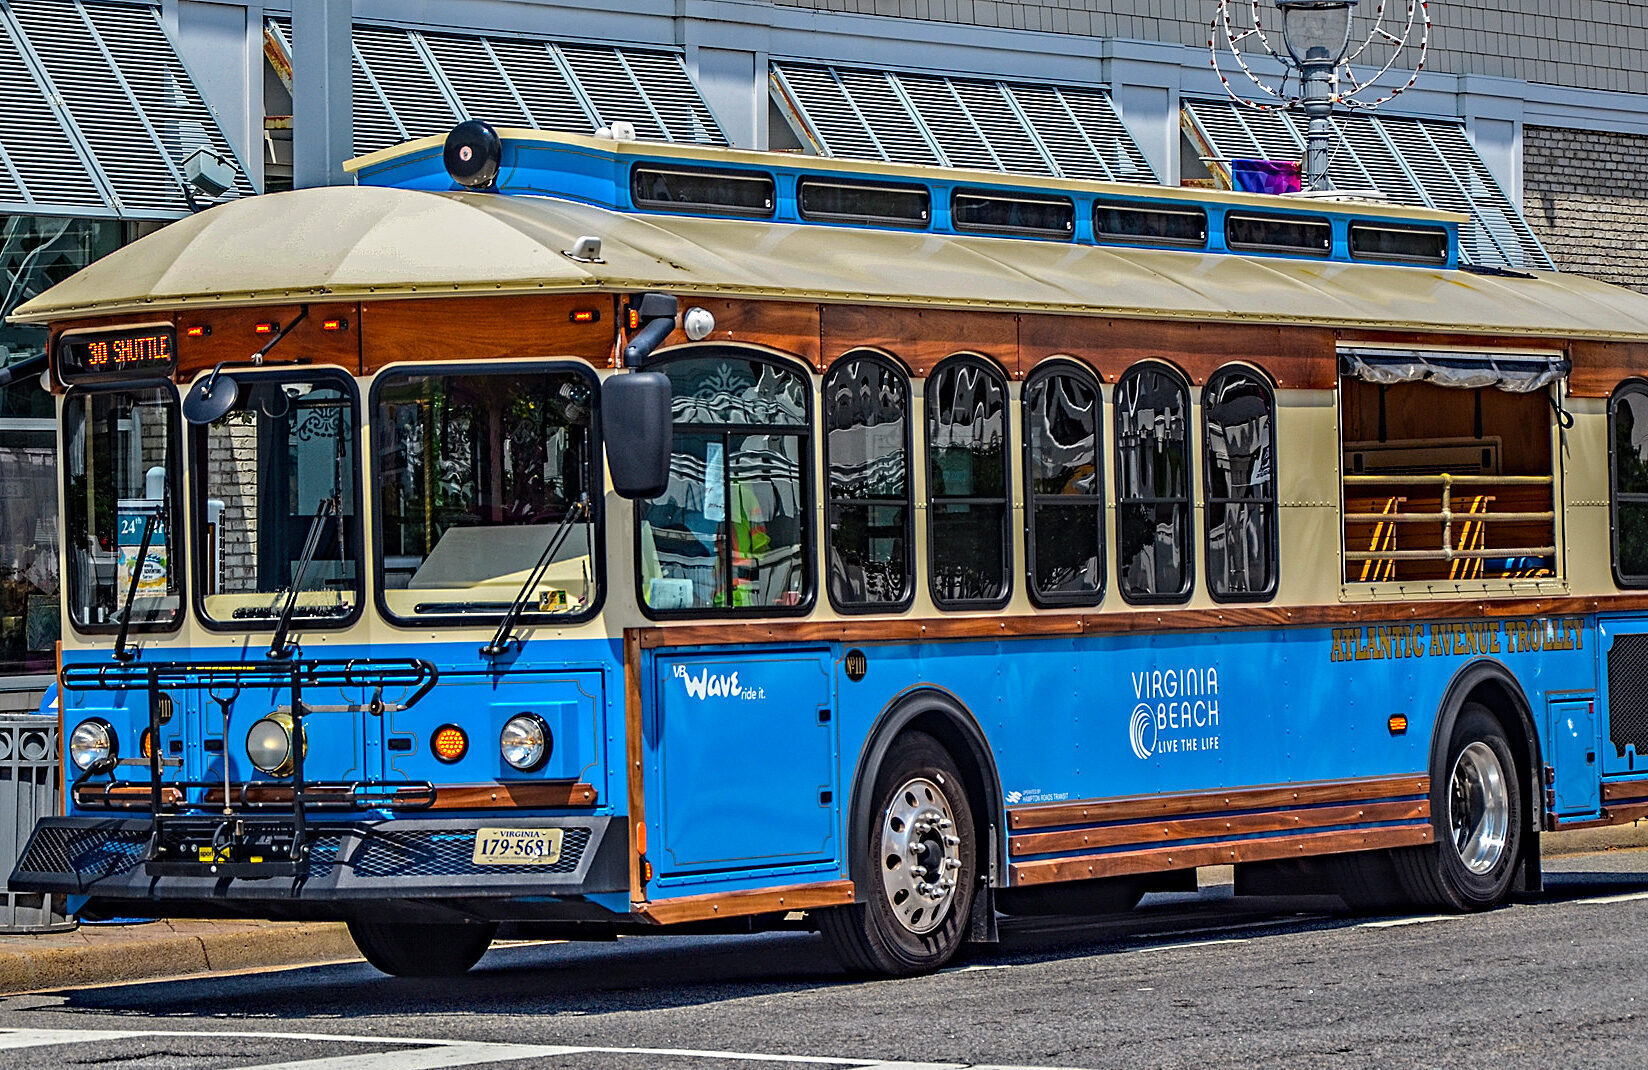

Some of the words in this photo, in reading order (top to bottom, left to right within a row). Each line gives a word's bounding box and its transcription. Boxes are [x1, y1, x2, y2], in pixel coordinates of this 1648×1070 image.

[88, 342, 108, 365] 30
[113, 336, 168, 362] SHUTTLE
[1331, 623, 1425, 662] ATLANTIC
[1429, 621, 1501, 656] AVENUE
[1505, 618, 1584, 653] TROLLEY
[673, 665, 686, 678] VB
[741, 687, 757, 700] ride
[758, 687, 766, 699] it.
[1131, 667, 1218, 700] VIRGINIA
[1157, 699, 1219, 729] BEACH
[1158, 739, 1178, 754] LIVE
[1181, 738, 1197, 752] THE
[1201, 736, 1219, 751] LIFE
[481, 839, 552, 856] 179-5681
